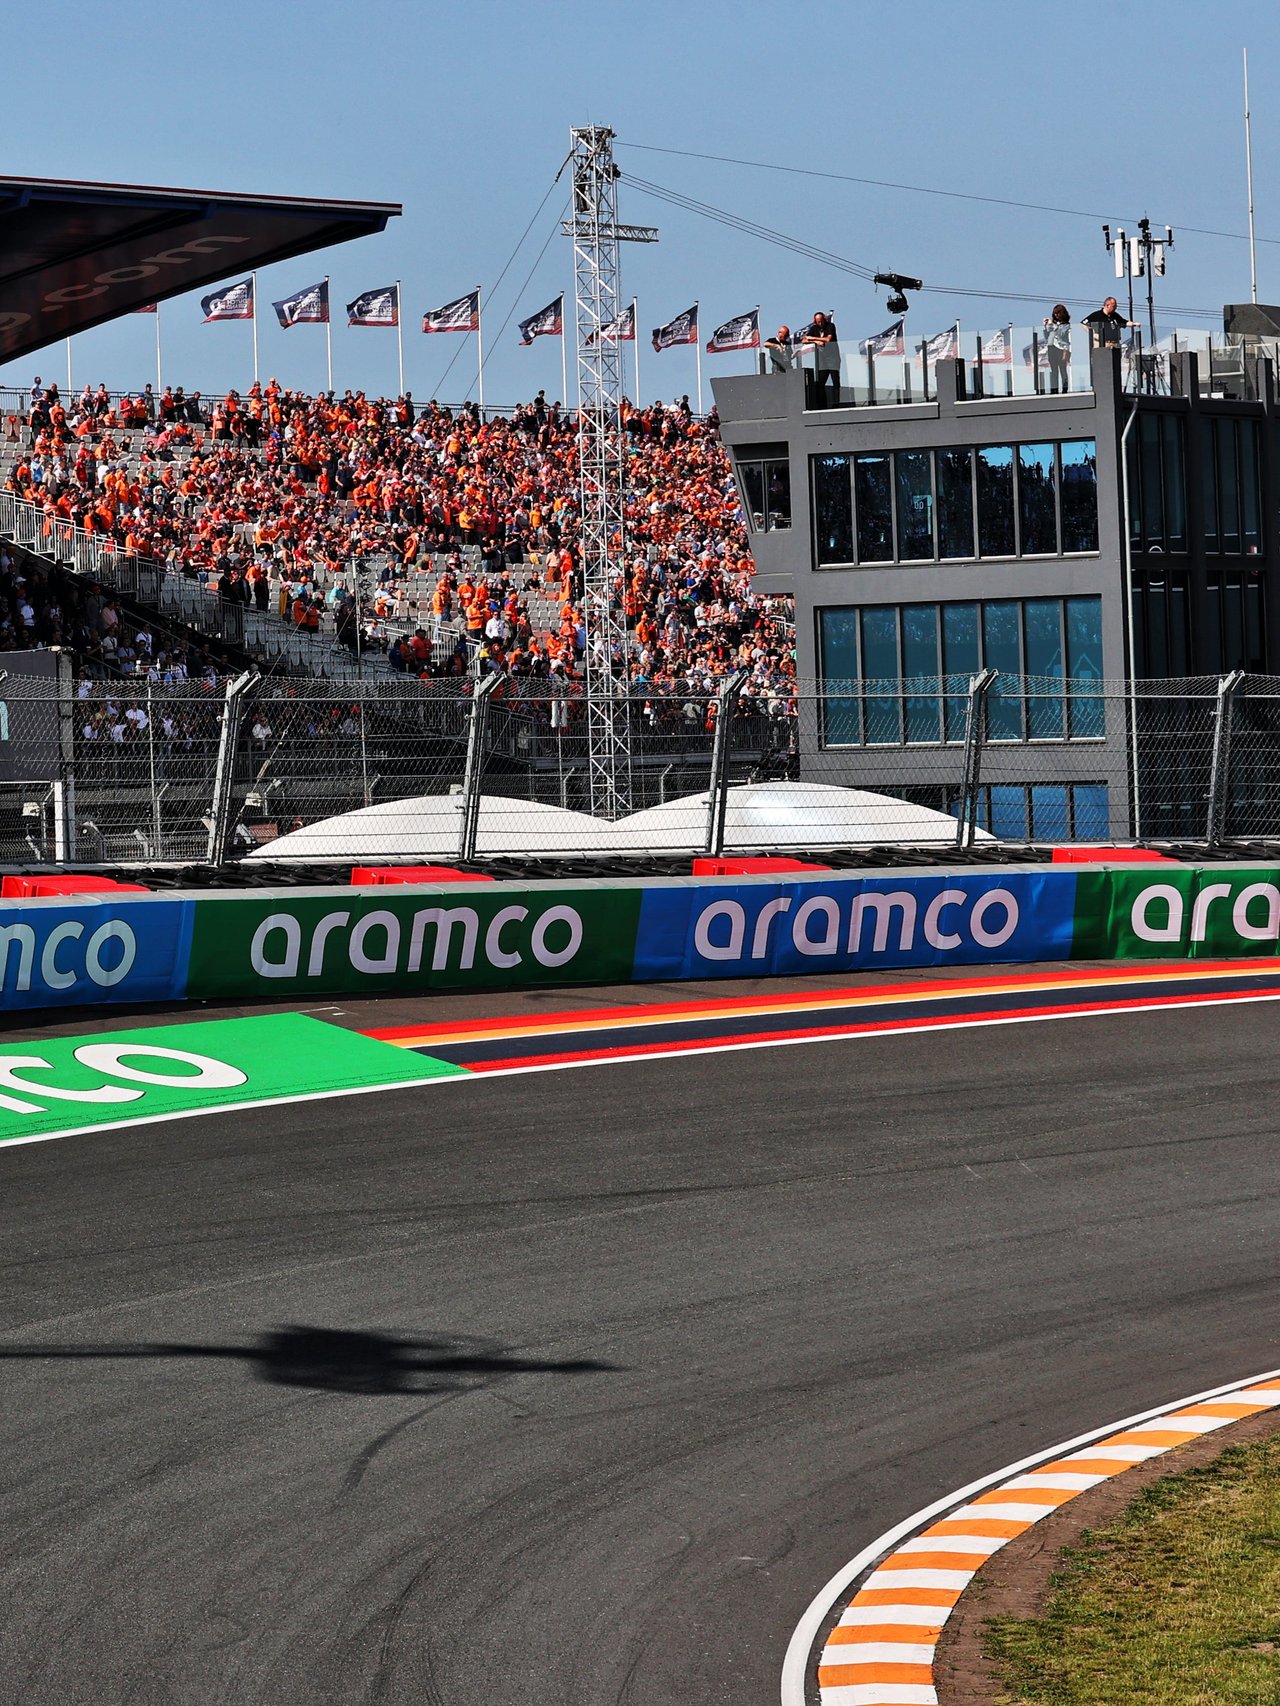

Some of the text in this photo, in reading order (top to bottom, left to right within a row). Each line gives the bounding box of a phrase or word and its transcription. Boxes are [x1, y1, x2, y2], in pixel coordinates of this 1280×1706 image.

[250, 904, 583, 978] aramco
[693, 888, 1019, 961] aramco
[1131, 882, 1280, 942] ara
